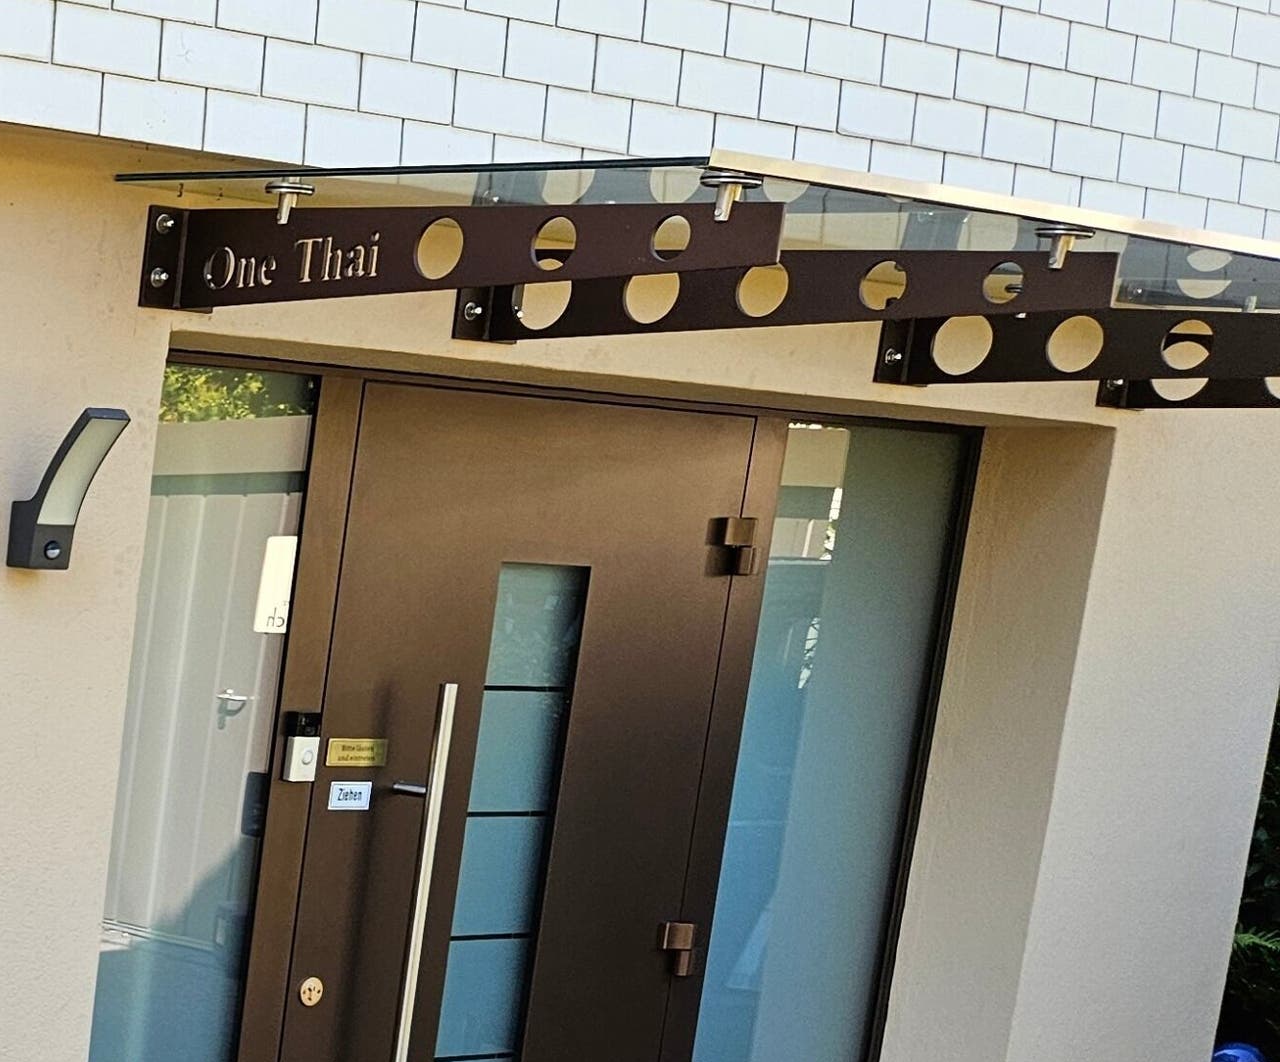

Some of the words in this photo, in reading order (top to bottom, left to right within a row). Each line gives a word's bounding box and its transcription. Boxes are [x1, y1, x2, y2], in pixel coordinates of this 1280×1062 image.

[203, 246, 276, 290] One
[295, 231, 380, 283] Thai
[337, 787, 362, 801] Ziehen
